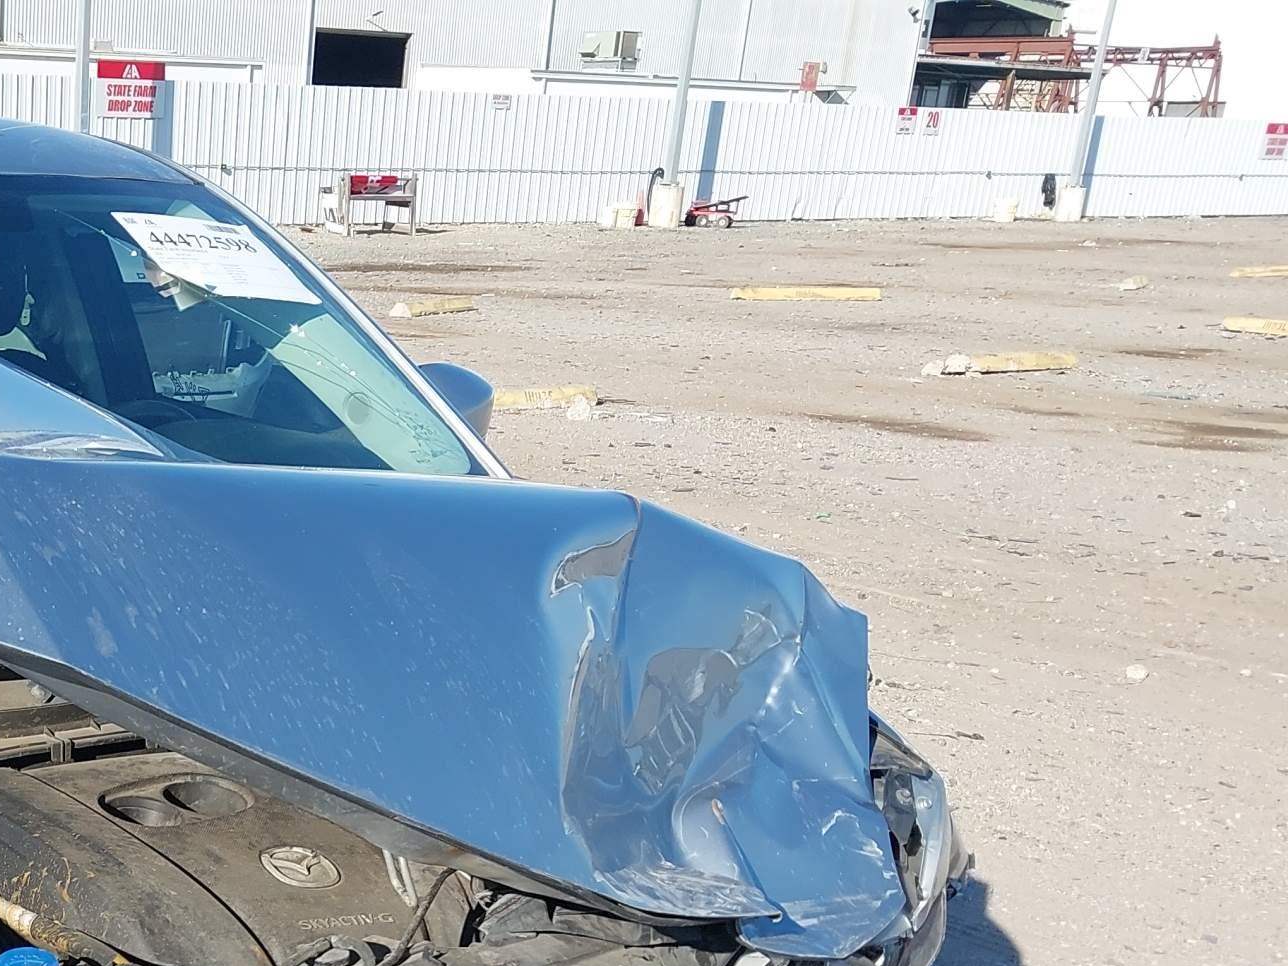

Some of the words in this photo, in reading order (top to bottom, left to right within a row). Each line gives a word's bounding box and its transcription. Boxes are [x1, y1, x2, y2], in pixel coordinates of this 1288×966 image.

[106, 84, 132, 97] STATE
[133, 85, 157, 98] FARM
[107, 99, 132, 112] DROP
[132, 100, 154, 113] ZONE
[926, 111, 940, 129] 20
[149, 231, 258, 254] 44472598
[298, 912, 394, 930] SKYACTIV-G
